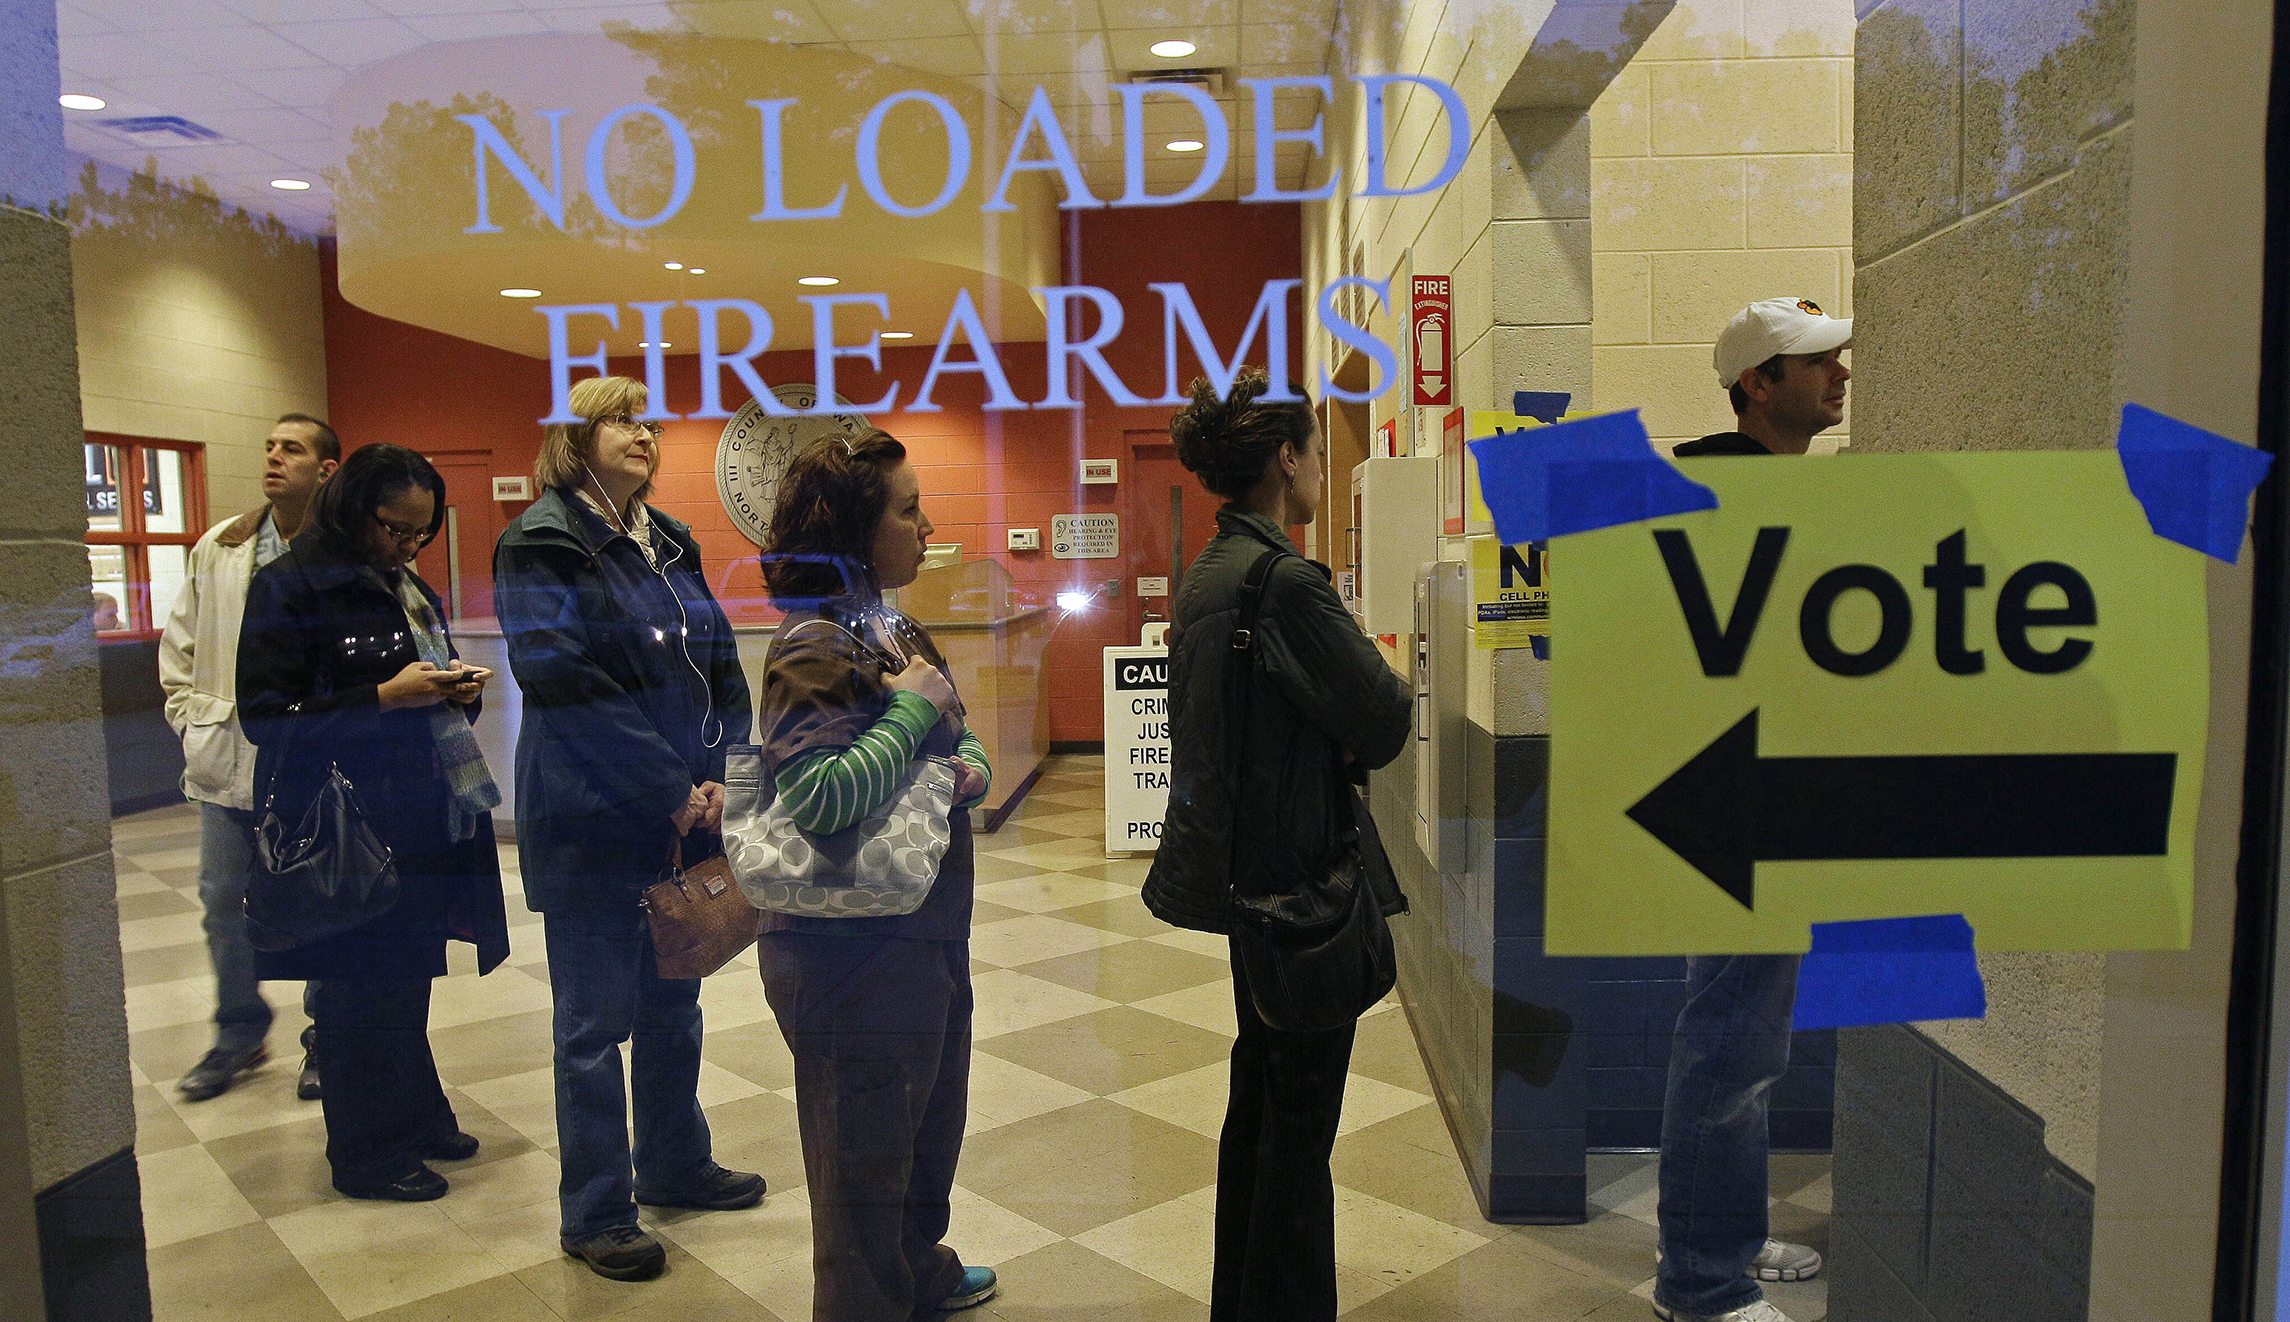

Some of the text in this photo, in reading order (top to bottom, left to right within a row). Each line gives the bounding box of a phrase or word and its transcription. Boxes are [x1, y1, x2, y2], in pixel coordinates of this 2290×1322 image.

[453, 73, 1472, 234] NO LOADED
[1414, 280, 1449, 295] FIRE
[533, 275, 1398, 425] FIREARMS
[734, 492, 769, 530] NORT
[1070, 519, 1114, 527] CAUTION
[1500, 543, 1548, 588] N
[1500, 591, 1550, 601] CELL PH
[1652, 526, 2098, 677] Vote
[1123, 665, 1168, 683] CAU
[1138, 723, 1171, 740] JUS
[1130, 747, 1170, 765] FIRE
[1133, 772, 1169, 789] TRA
[1128, 821, 1164, 839] PRO
